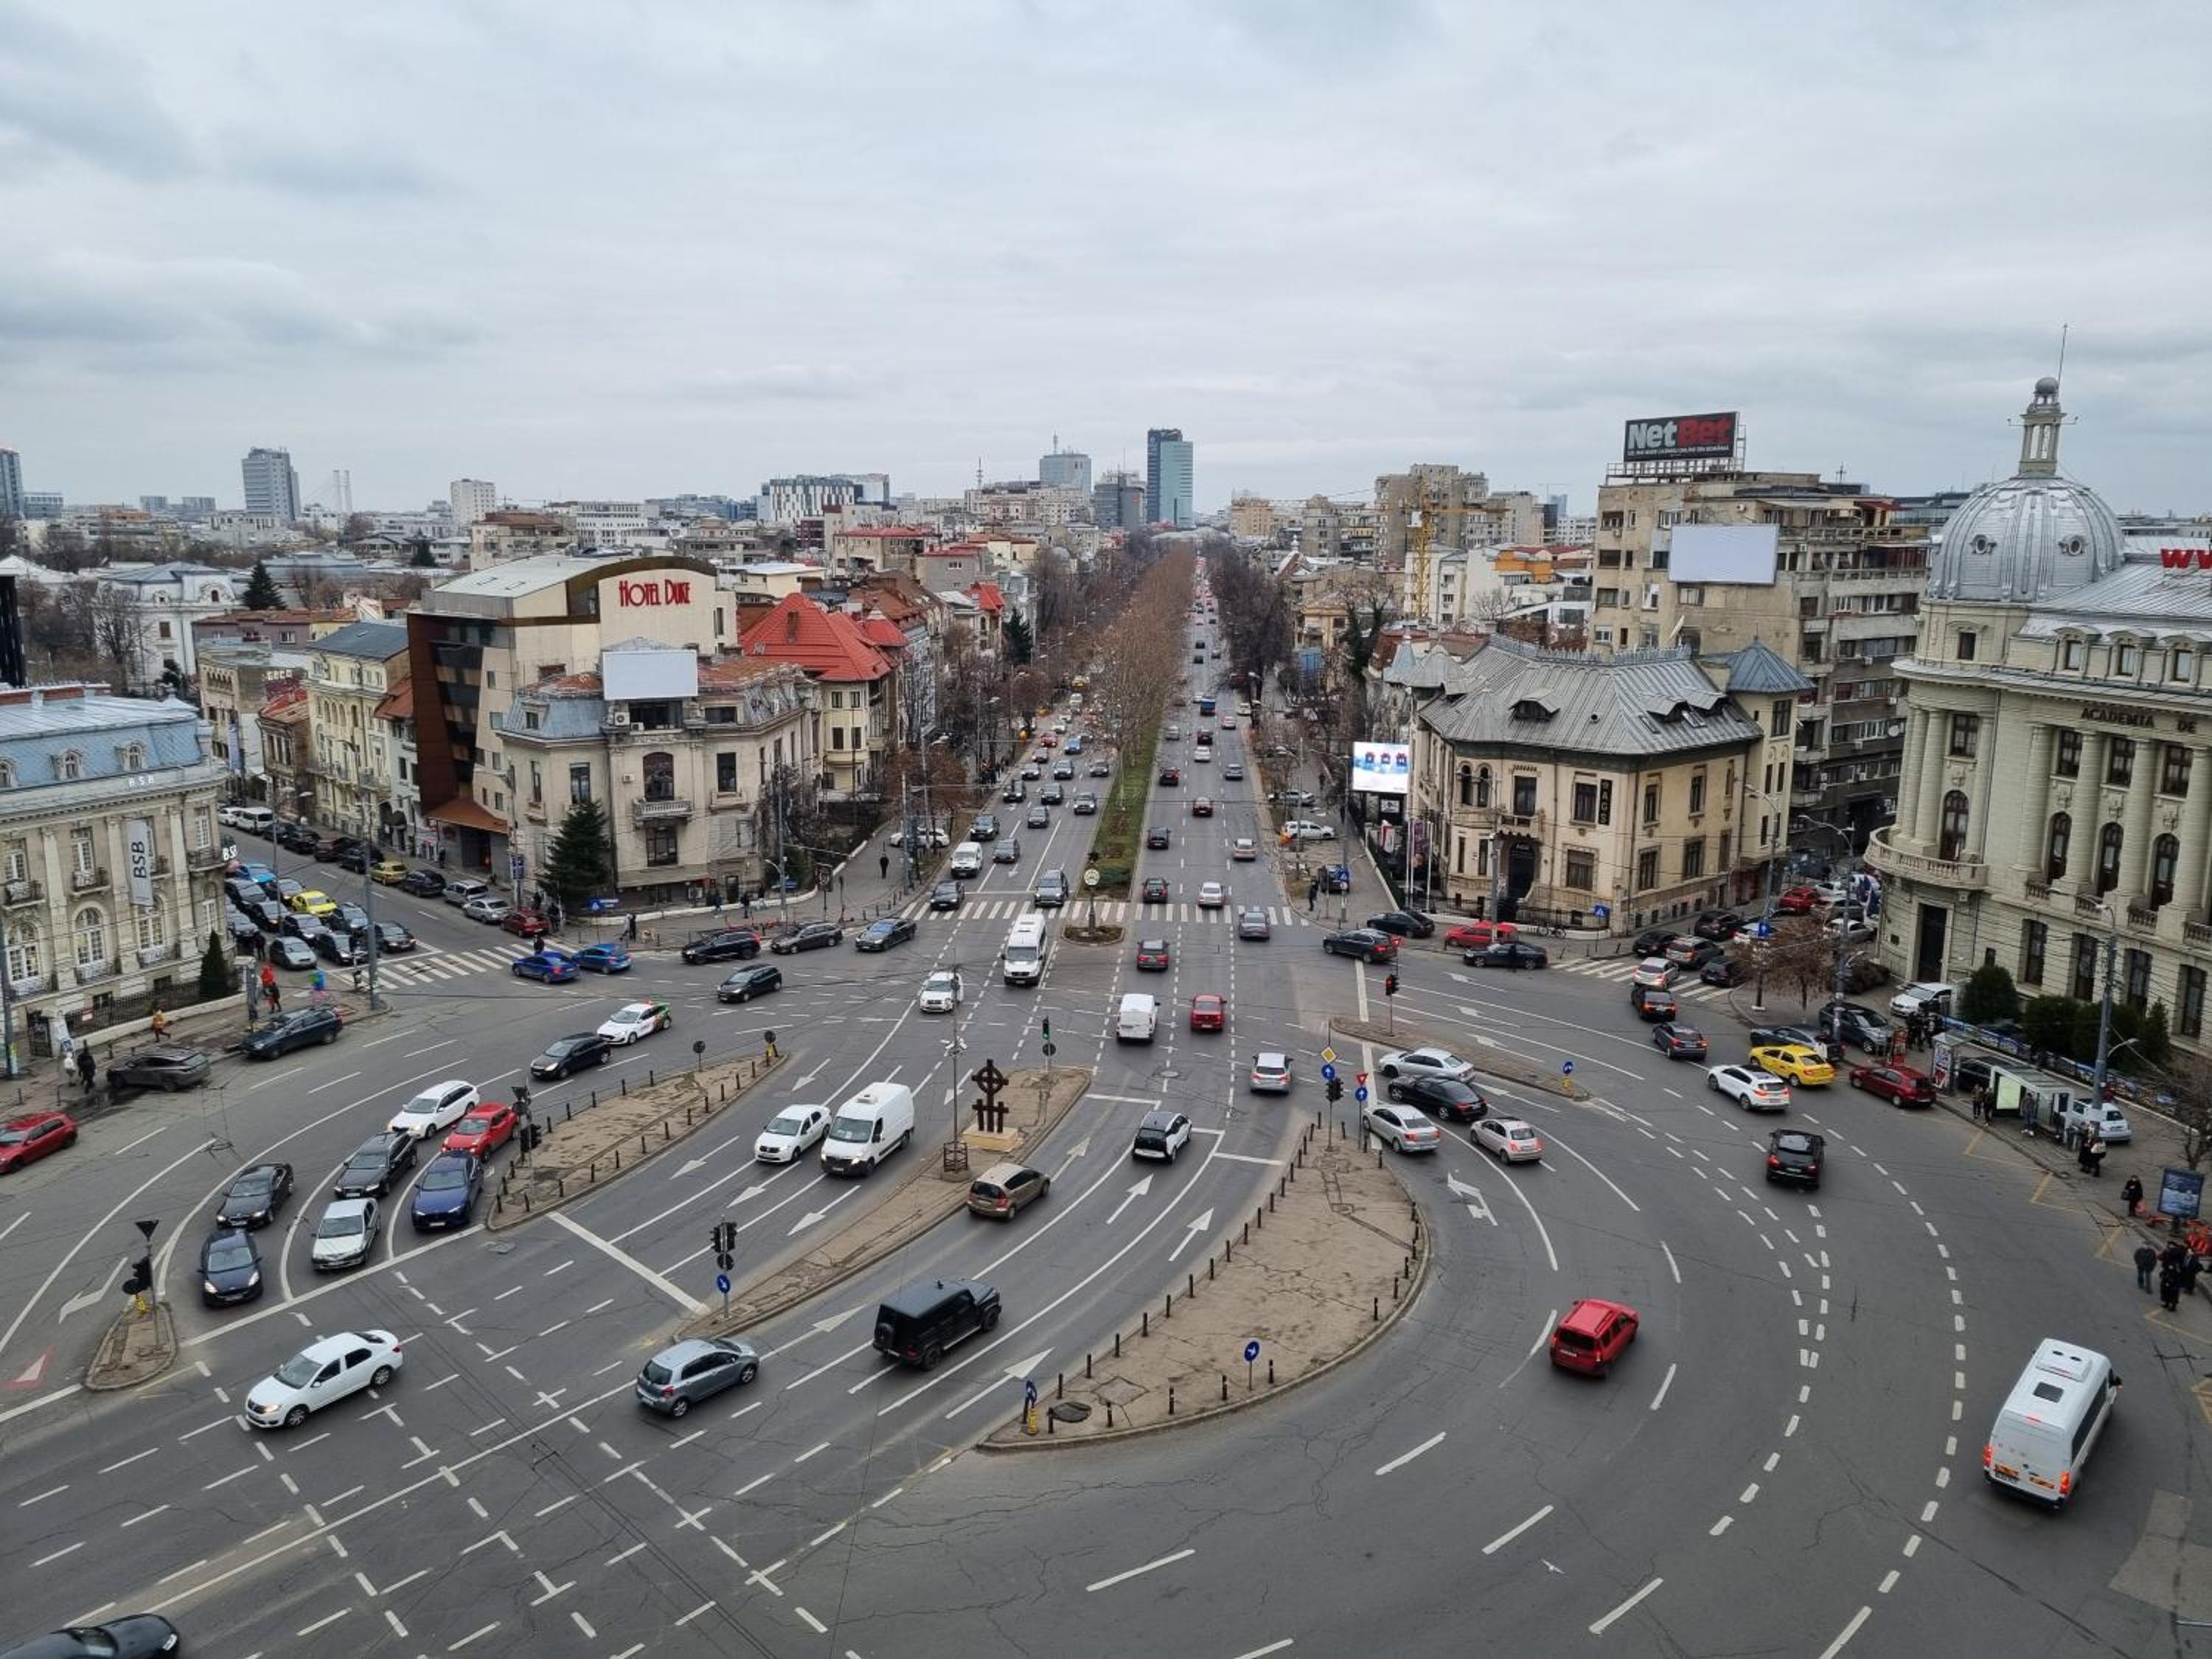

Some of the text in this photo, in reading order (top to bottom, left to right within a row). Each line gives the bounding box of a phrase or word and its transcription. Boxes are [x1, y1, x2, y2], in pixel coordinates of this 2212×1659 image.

[1627, 417, 1732, 449] NetBet
[619, 579, 691, 607] HOTEL DUKE
[2081, 707, 2197, 734] ACADEMIA DE
[129, 776, 153, 787] BSB
[131, 841, 147, 879] BSB
[222, 845, 237, 860] BS
